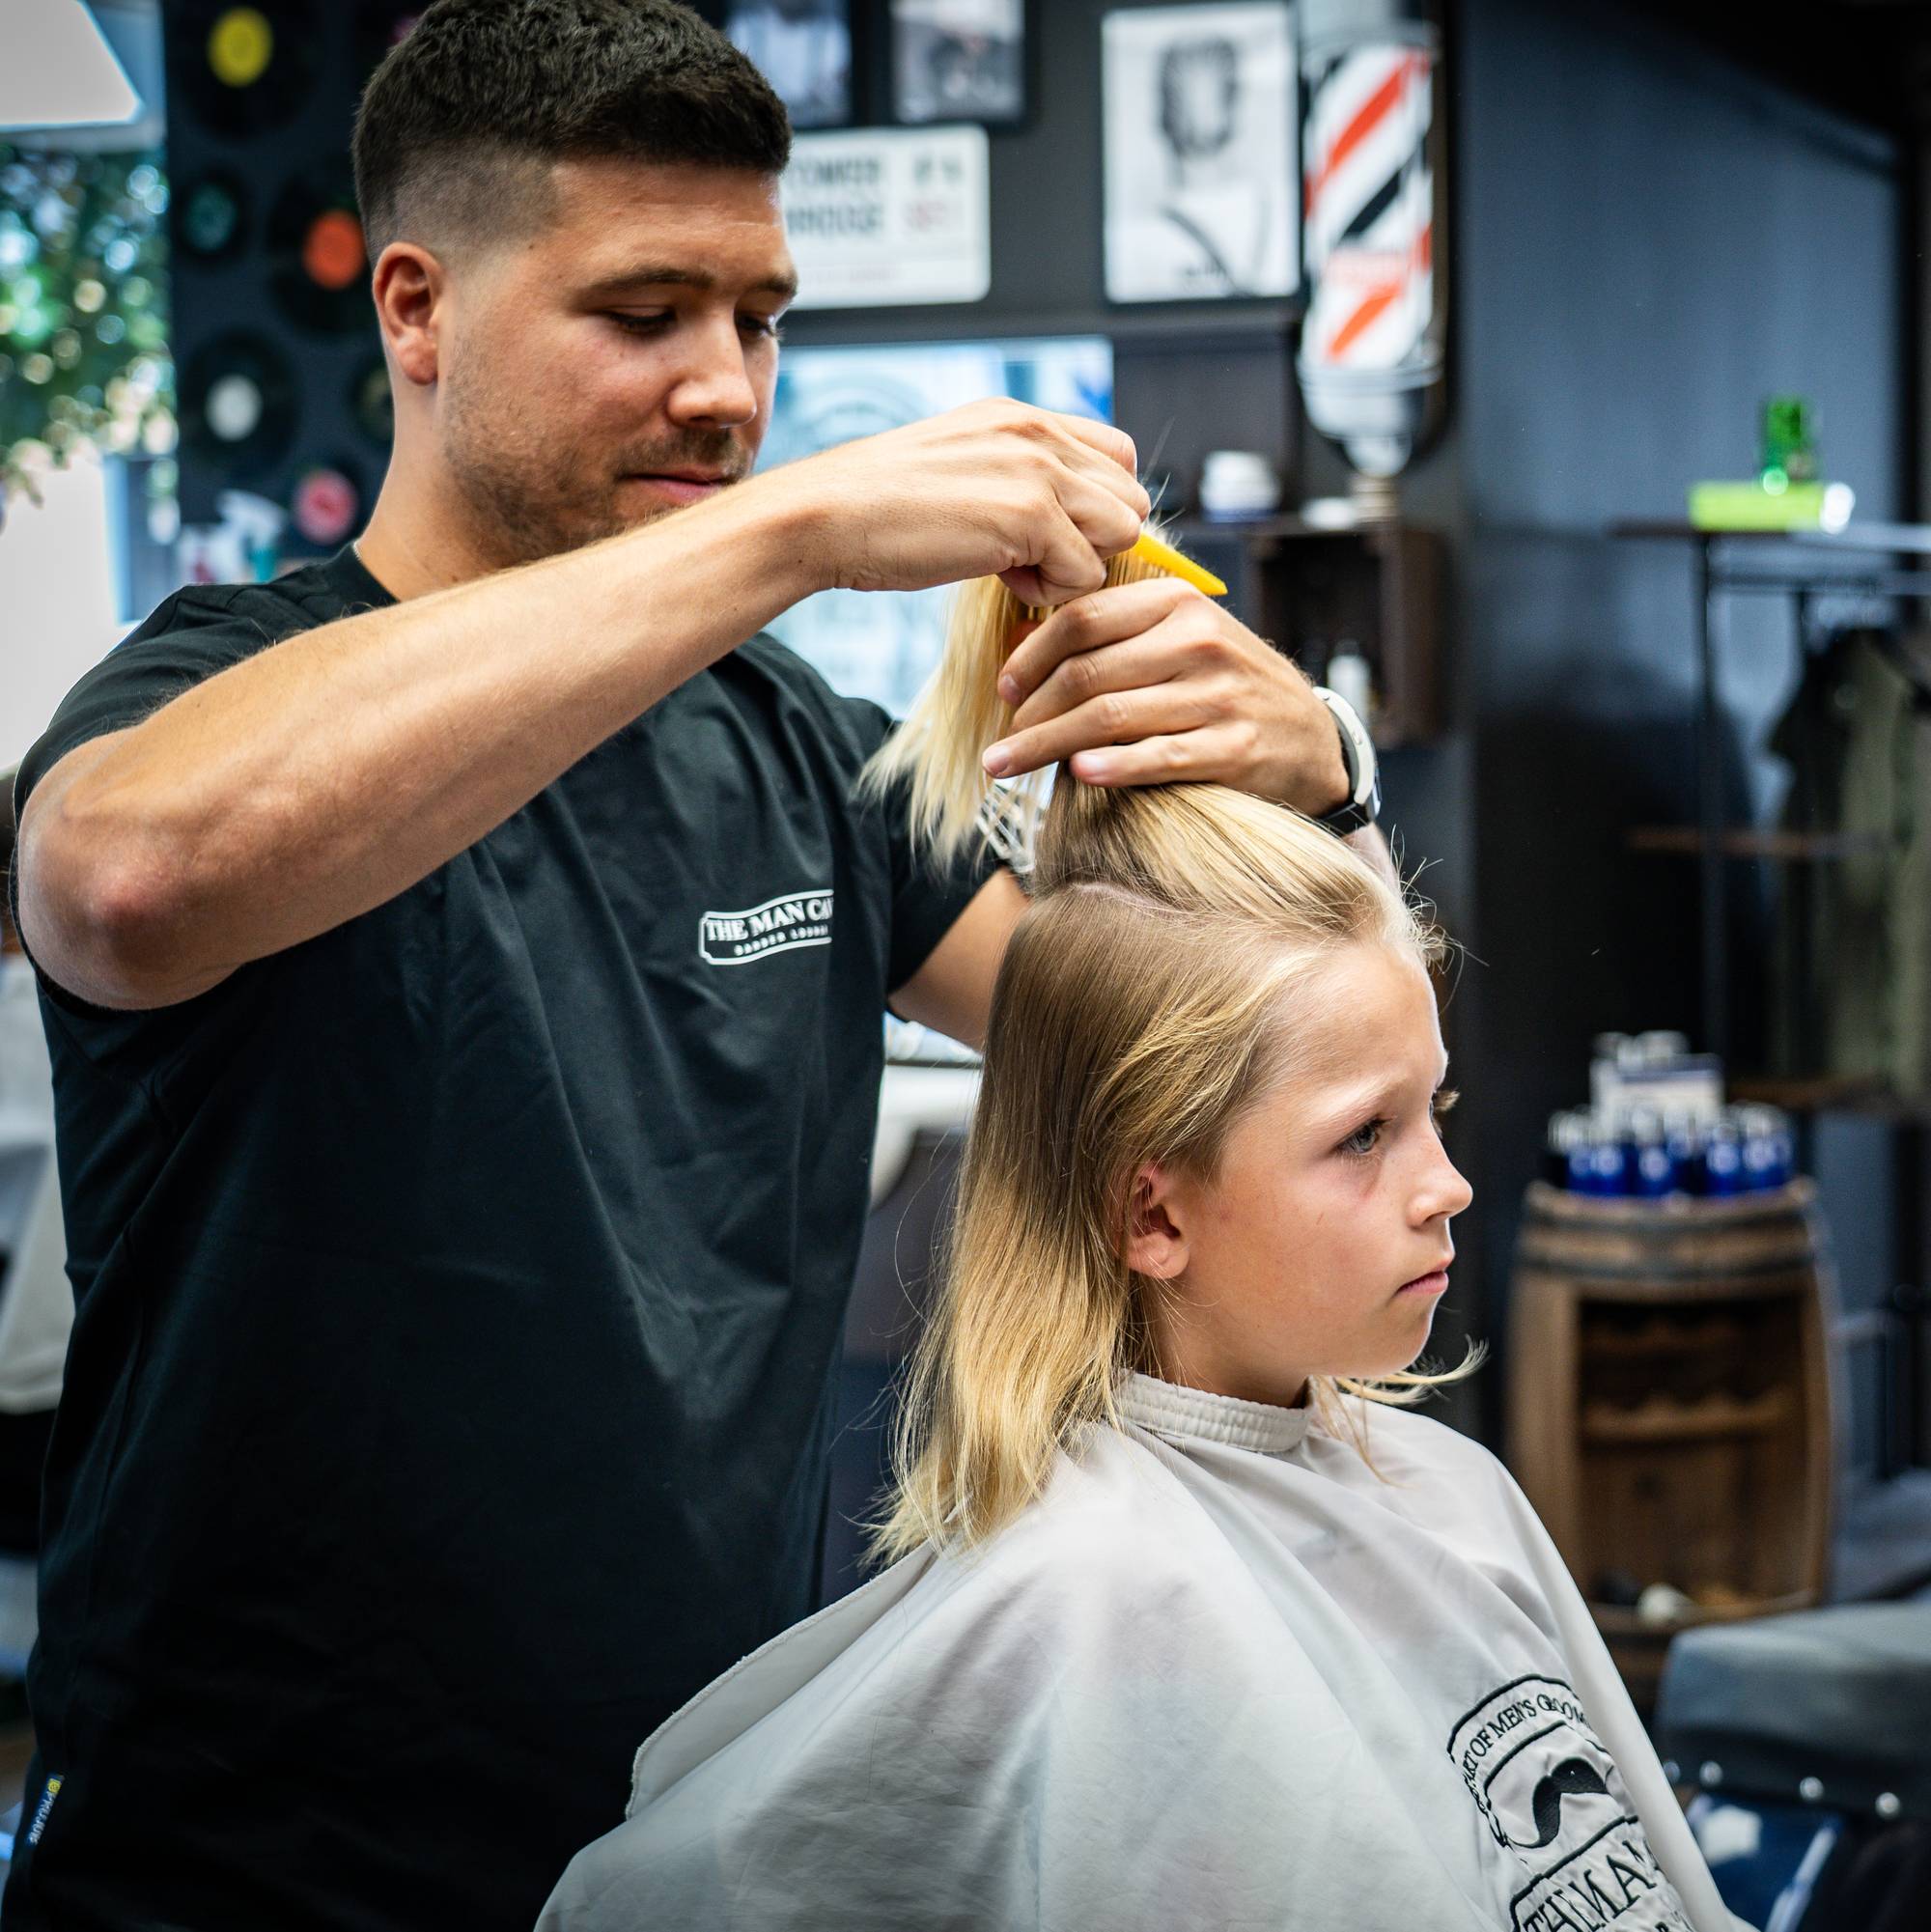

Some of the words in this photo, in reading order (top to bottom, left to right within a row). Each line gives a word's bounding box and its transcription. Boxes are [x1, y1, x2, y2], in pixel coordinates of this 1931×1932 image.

[705, 918, 749, 941] THE
[747, 901, 806, 937] MAN
[806, 897, 834, 921] CAV
[1469, 1727, 1494, 1757] OF
[1537, 1694, 1588, 1727] GROOM
